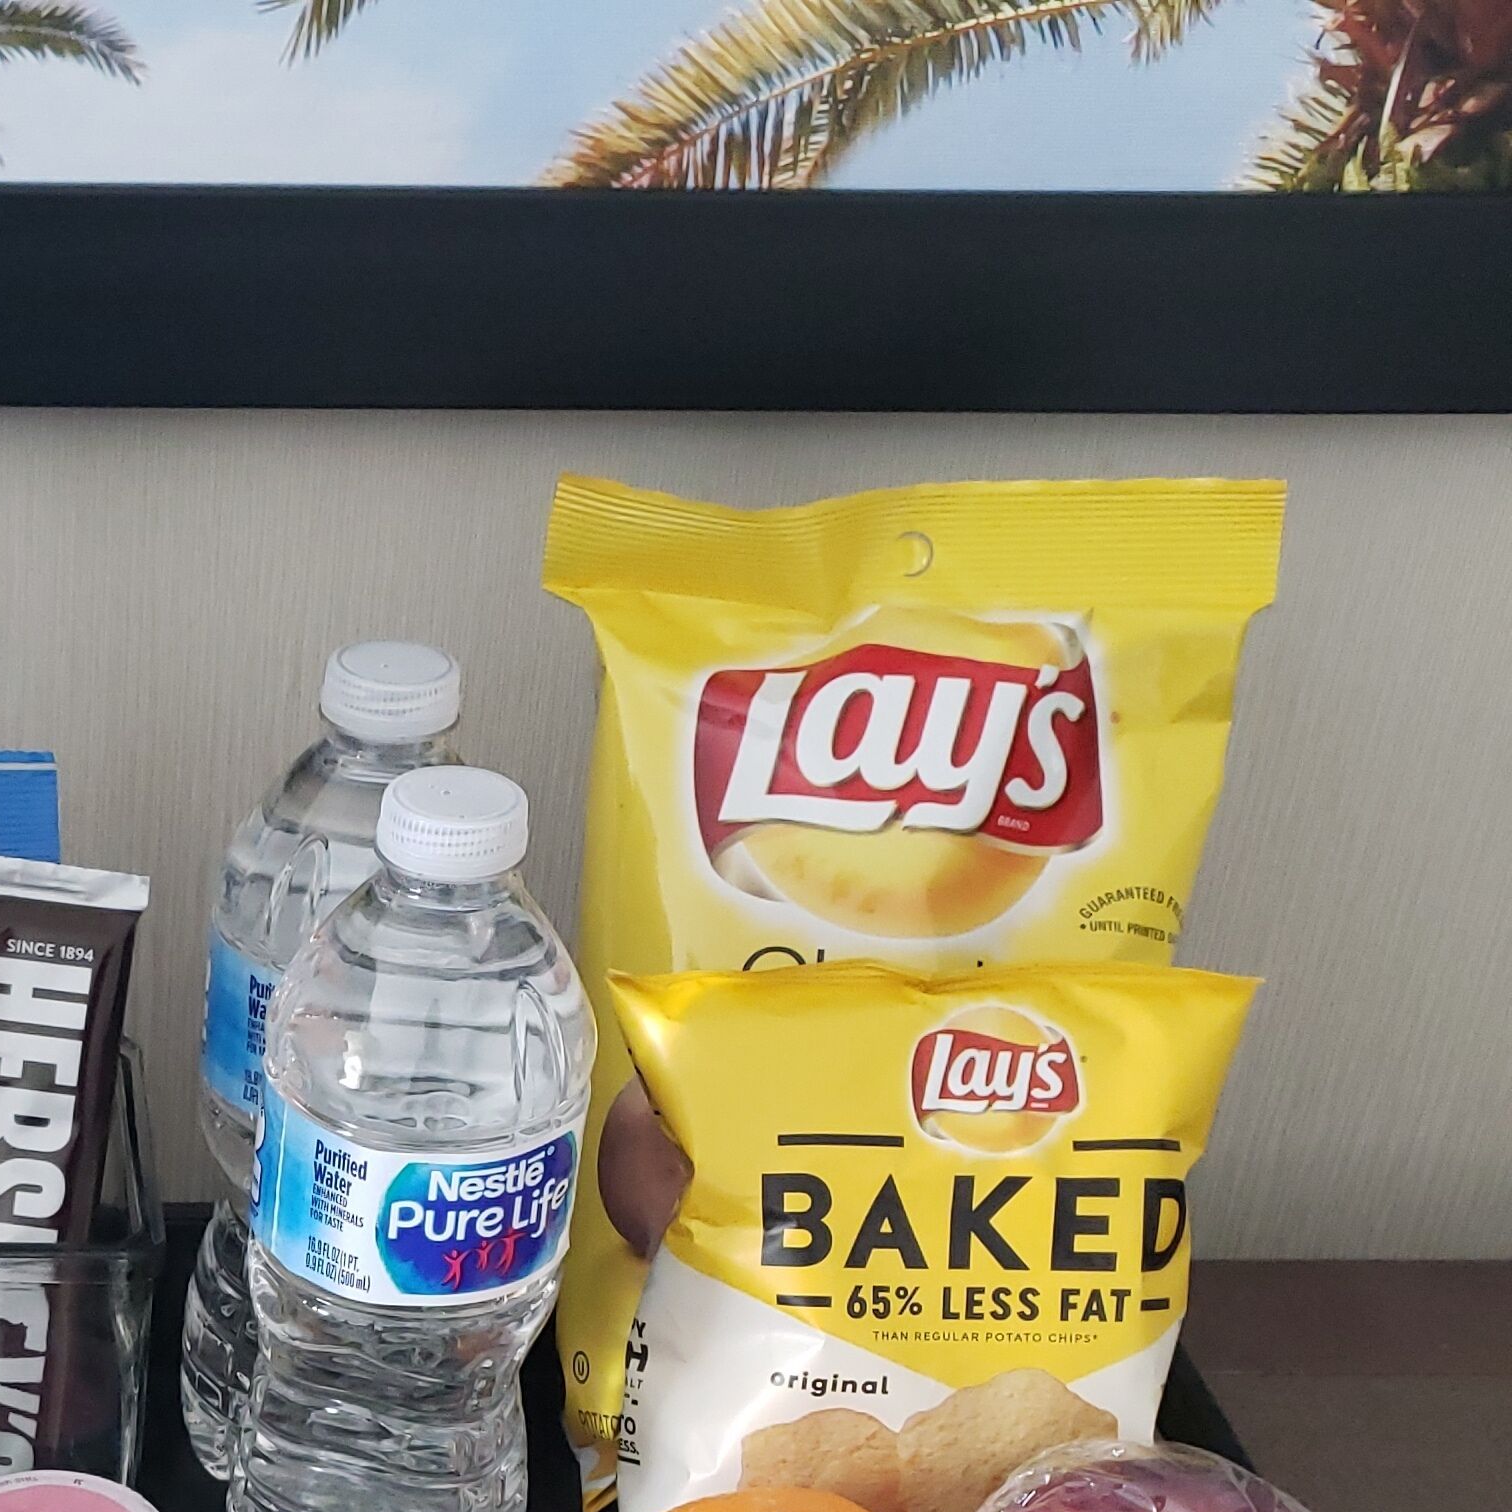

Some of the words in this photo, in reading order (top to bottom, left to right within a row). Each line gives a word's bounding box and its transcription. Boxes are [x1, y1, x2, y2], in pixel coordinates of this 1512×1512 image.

[718, 664, 1086, 833] Lay's
[997, 814, 1032, 832] BRAND
[1079, 886, 1165, 920] GUARANTEED
[1089, 920, 1125, 934] UNTIL
[1126, 921, 1166, 942] PRINTED
[5, 938, 55, 957] SINCE
[58, 944, 95, 963] 1894
[920, 1032, 1068, 1114] Lay's
[314, 1138, 368, 1182] Purified
[428, 1151, 547, 1202] Nestlé
[312, 1183, 348, 1208] ENHANCED
[313, 1161, 353, 1197] Water
[310, 1207, 323, 1223] FOR
[324, 1216, 344, 1233] TASTE
[311, 1195, 329, 1212] WITH
[330, 1204, 364, 1228] MINERALS
[388, 1199, 505, 1242] Pure
[511, 1176, 569, 1239] Life
[761, 1172, 1186, 1273] BAKED
[307, 1235, 323, 1252] 16.9
[322, 1243, 331, 1257] FL
[348, 1254, 360, 1273] PT.
[305, 1252, 318, 1271] 0.9
[317, 1259, 326, 1275] FL
[338, 1267, 355, 1288] (500
[355, 1274, 371, 1294] mL)
[846, 1284, 923, 1319] 65%
[941, 1286, 1040, 1322] LESS
[1059, 1288, 1132, 1323] FAT
[872, 1330, 909, 1342] THAN
[914, 1331, 980, 1343] REGULAR
[985, 1332, 1042, 1343] POTATO
[769, 1370, 889, 1397] original
